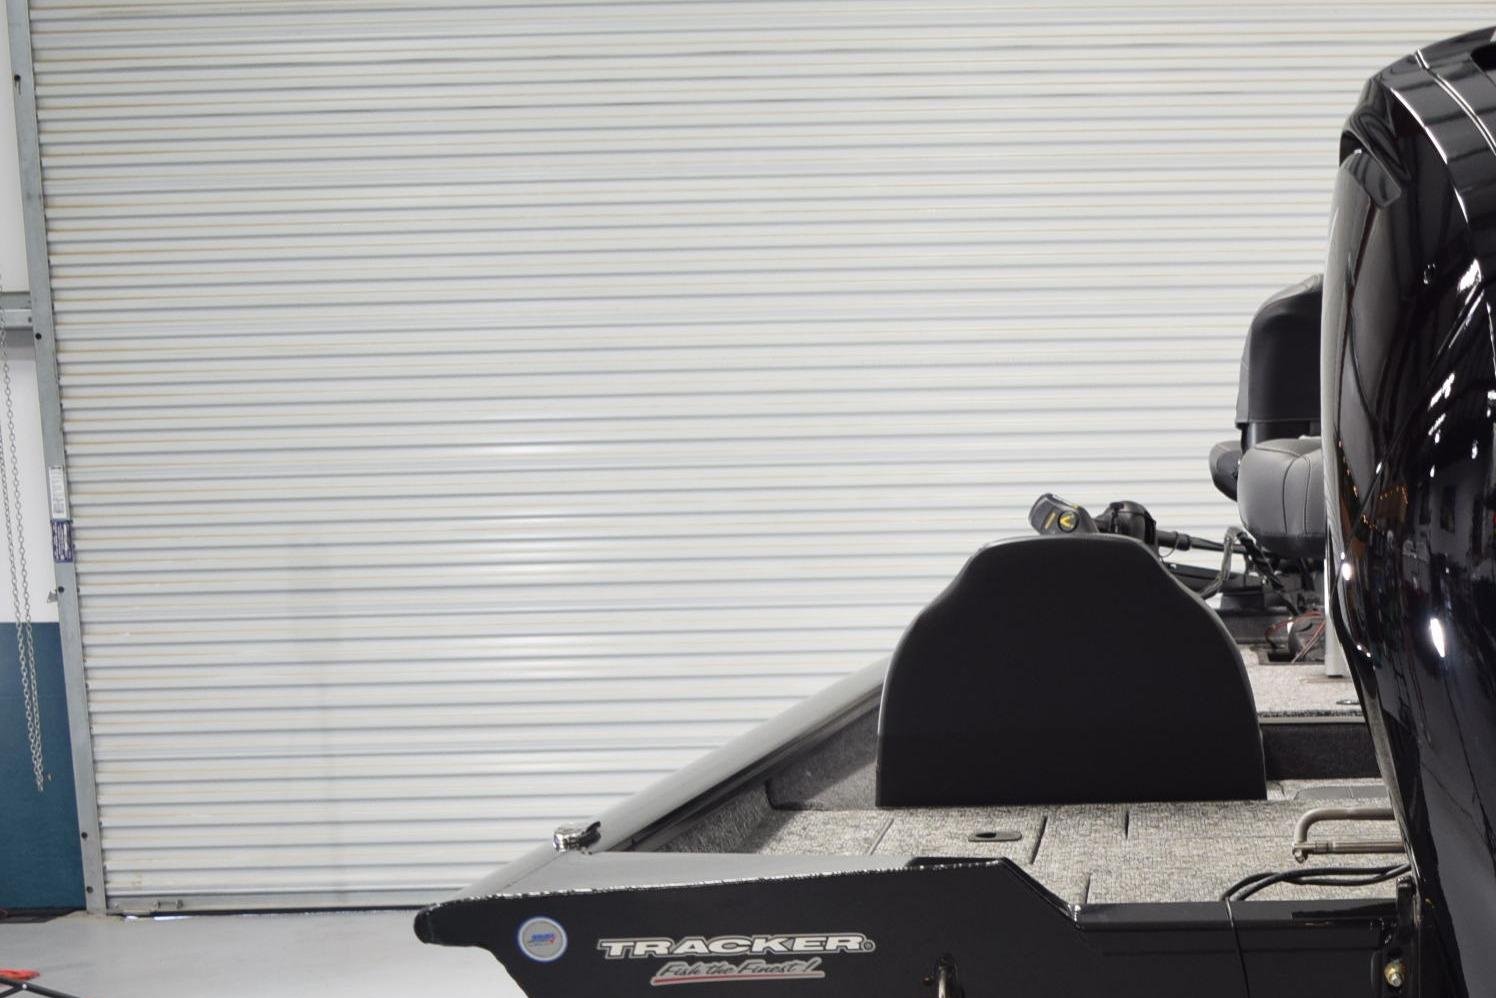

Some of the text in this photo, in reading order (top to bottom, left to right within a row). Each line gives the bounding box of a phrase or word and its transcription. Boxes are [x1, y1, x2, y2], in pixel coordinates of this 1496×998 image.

[599, 934, 865, 958] TRACKER
[660, 961, 698, 977] Fish
[705, 961, 735, 975] the
